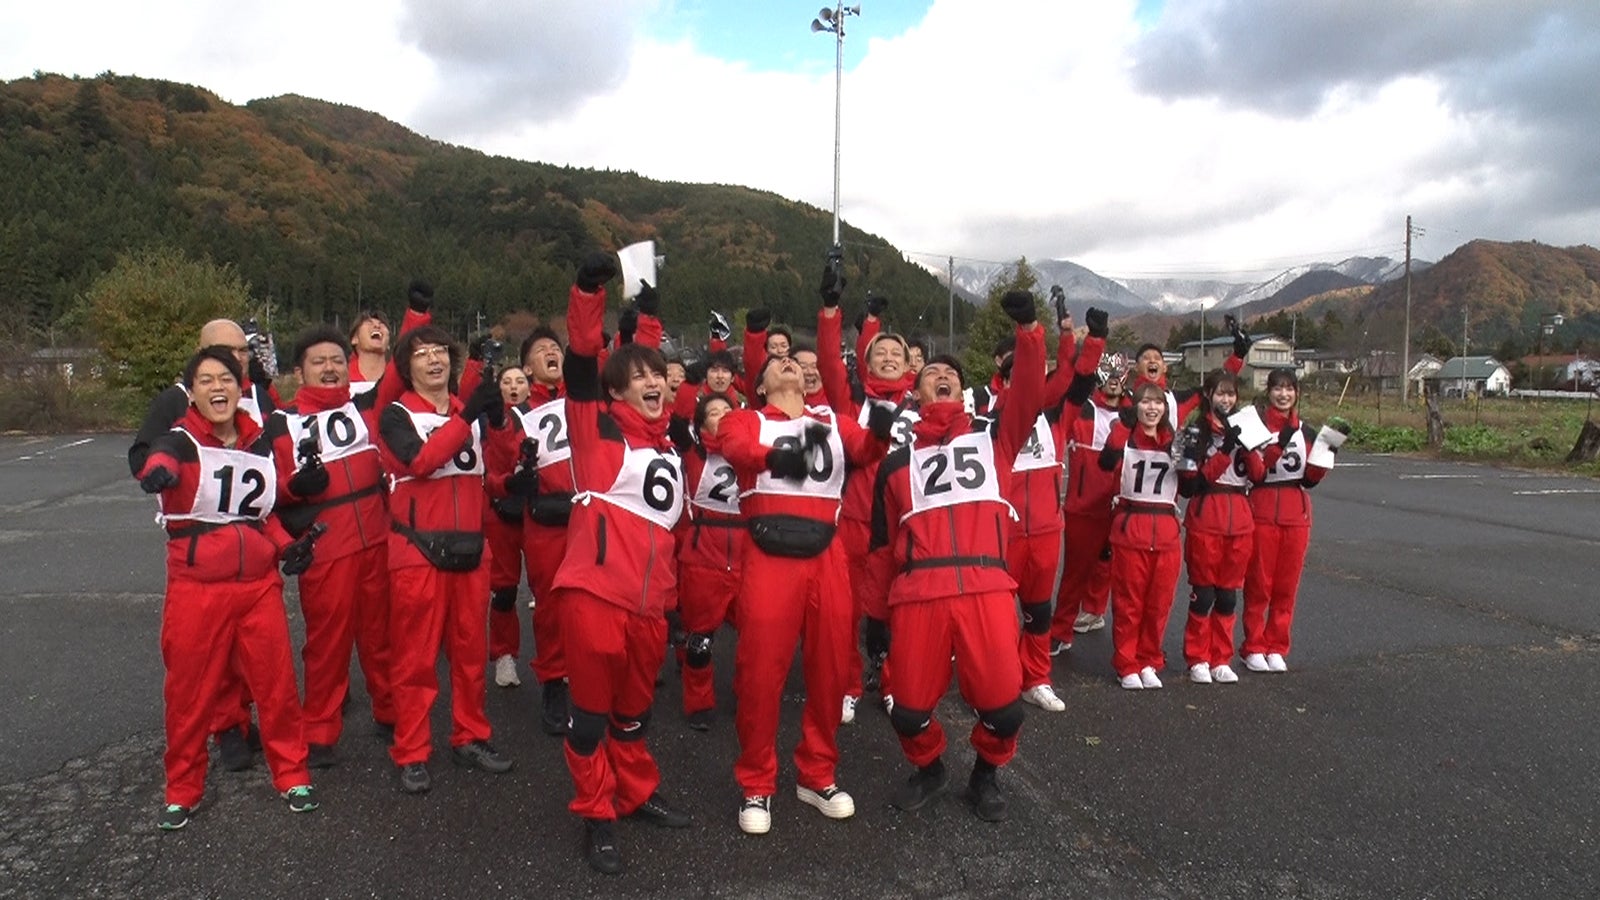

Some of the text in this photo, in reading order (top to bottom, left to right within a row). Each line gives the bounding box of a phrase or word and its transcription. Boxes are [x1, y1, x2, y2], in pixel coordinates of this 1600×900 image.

[921, 447, 986, 496] 25
[1131, 460, 1170, 494] 17
[1268, 442, 1302, 474] 5
[213, 465, 266, 515] 12
[643, 458, 678, 512] 6
